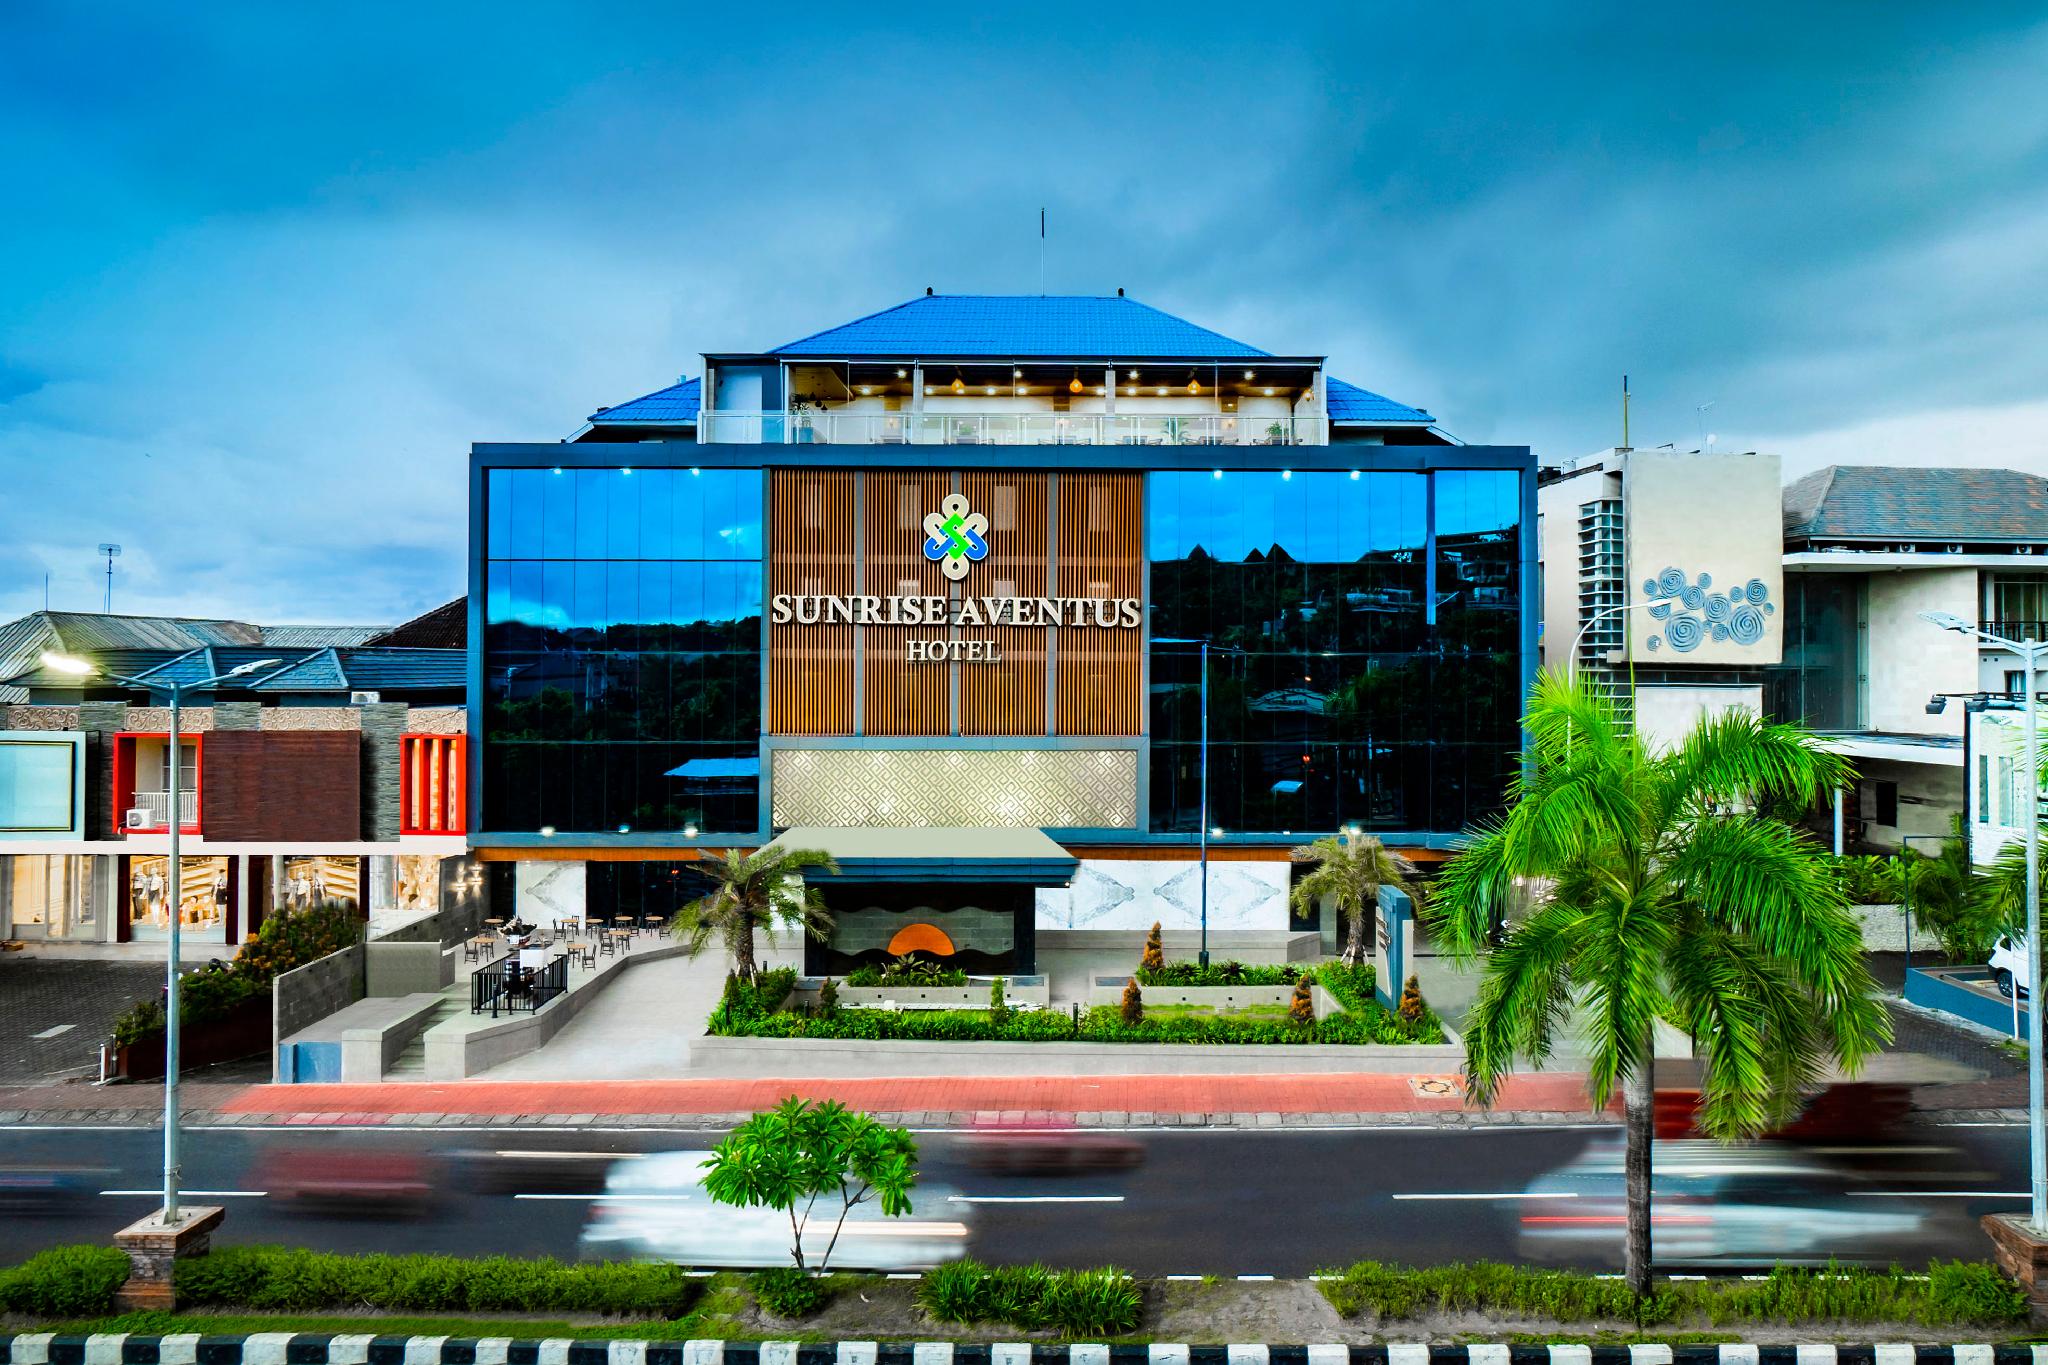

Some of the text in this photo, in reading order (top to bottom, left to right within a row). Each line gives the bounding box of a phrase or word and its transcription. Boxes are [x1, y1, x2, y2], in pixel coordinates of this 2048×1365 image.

[772, 594, 1142, 628] SUNRISE AVENTUS
[906, 640, 1002, 663] HOTEL
